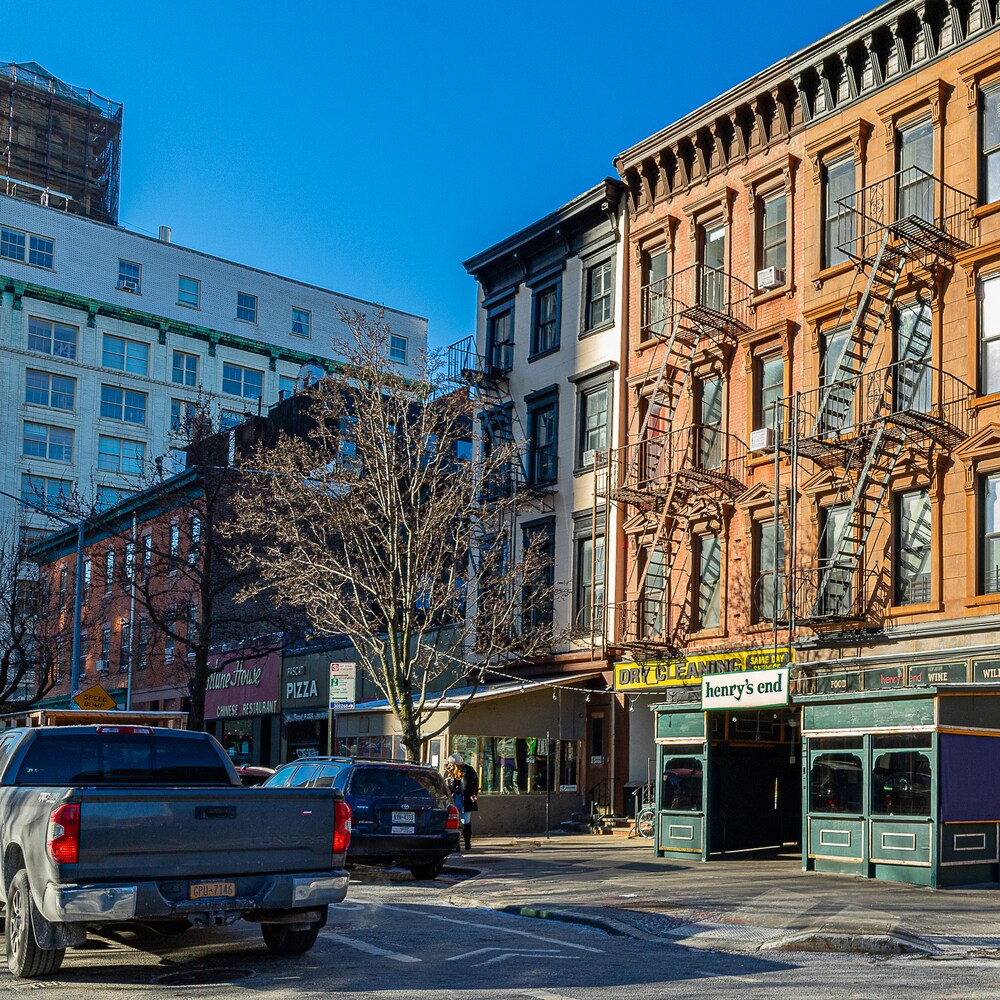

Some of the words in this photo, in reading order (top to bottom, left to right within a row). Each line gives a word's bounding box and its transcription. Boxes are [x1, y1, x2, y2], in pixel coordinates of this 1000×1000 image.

[750, 655, 769, 665] SAME
[619, 665, 650, 685] DRY
[656, 658, 743, 682] CLEANING
[928, 673, 948, 682] WINE
[705, 679, 754, 701] henry's
[756, 673, 783, 693] end
[830, 679, 847, 689] FOOD
[286, 680, 318, 699] PIZZA
[83, 693, 108, 703] SPEED
[83, 701, 105, 709] BUMP
[217, 704, 239, 717] CHINESE
[242, 700, 277, 715] RESTAURANT
